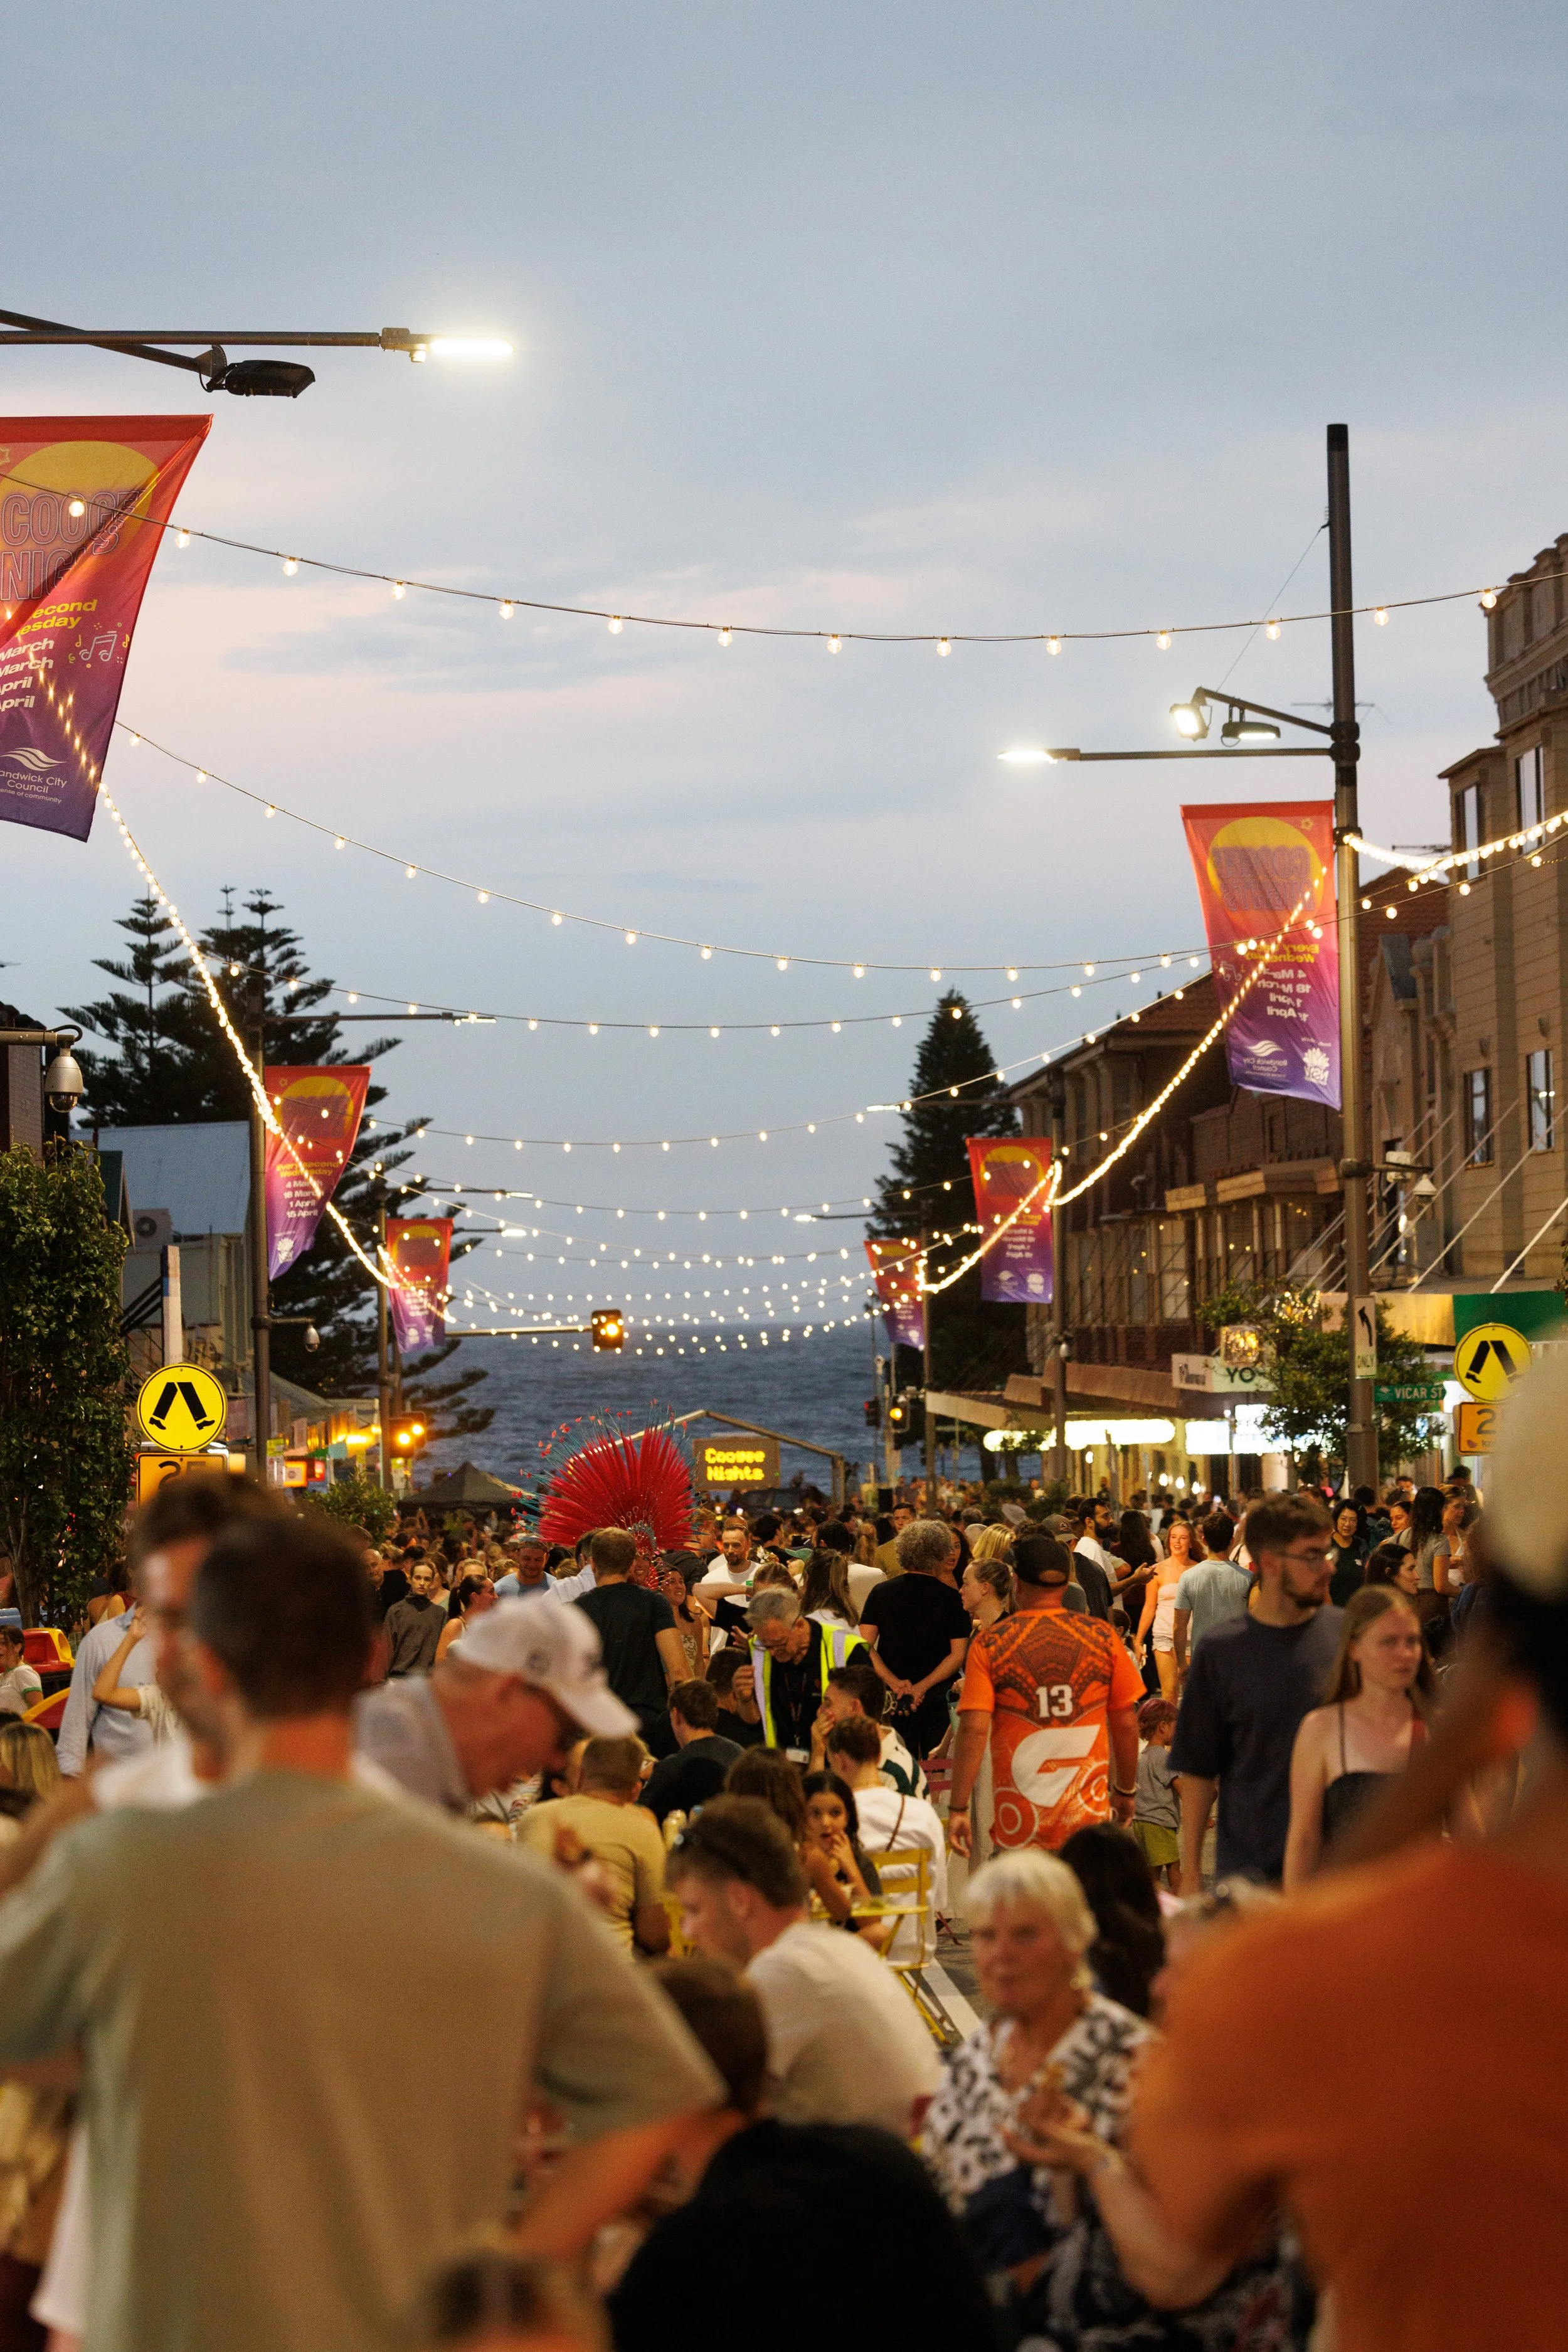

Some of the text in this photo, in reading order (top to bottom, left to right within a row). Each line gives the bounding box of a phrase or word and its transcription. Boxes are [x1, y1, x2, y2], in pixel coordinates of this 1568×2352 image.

[31, 599, 98, 619] econd
[15, 615, 82, 637] esday
[0, 676, 33, 695] pril
[0, 695, 35, 711] pril
[0, 770, 67, 788] andwick City
[7, 780, 49, 794] Council
[24, 793, 61, 804] community
[1394, 1386, 1444, 1399] VICAR ST
[705, 1447, 765, 1464] Coogee
[707, 1466, 765, 1481] Nights
[1036, 1684, 1073, 1718] 13
